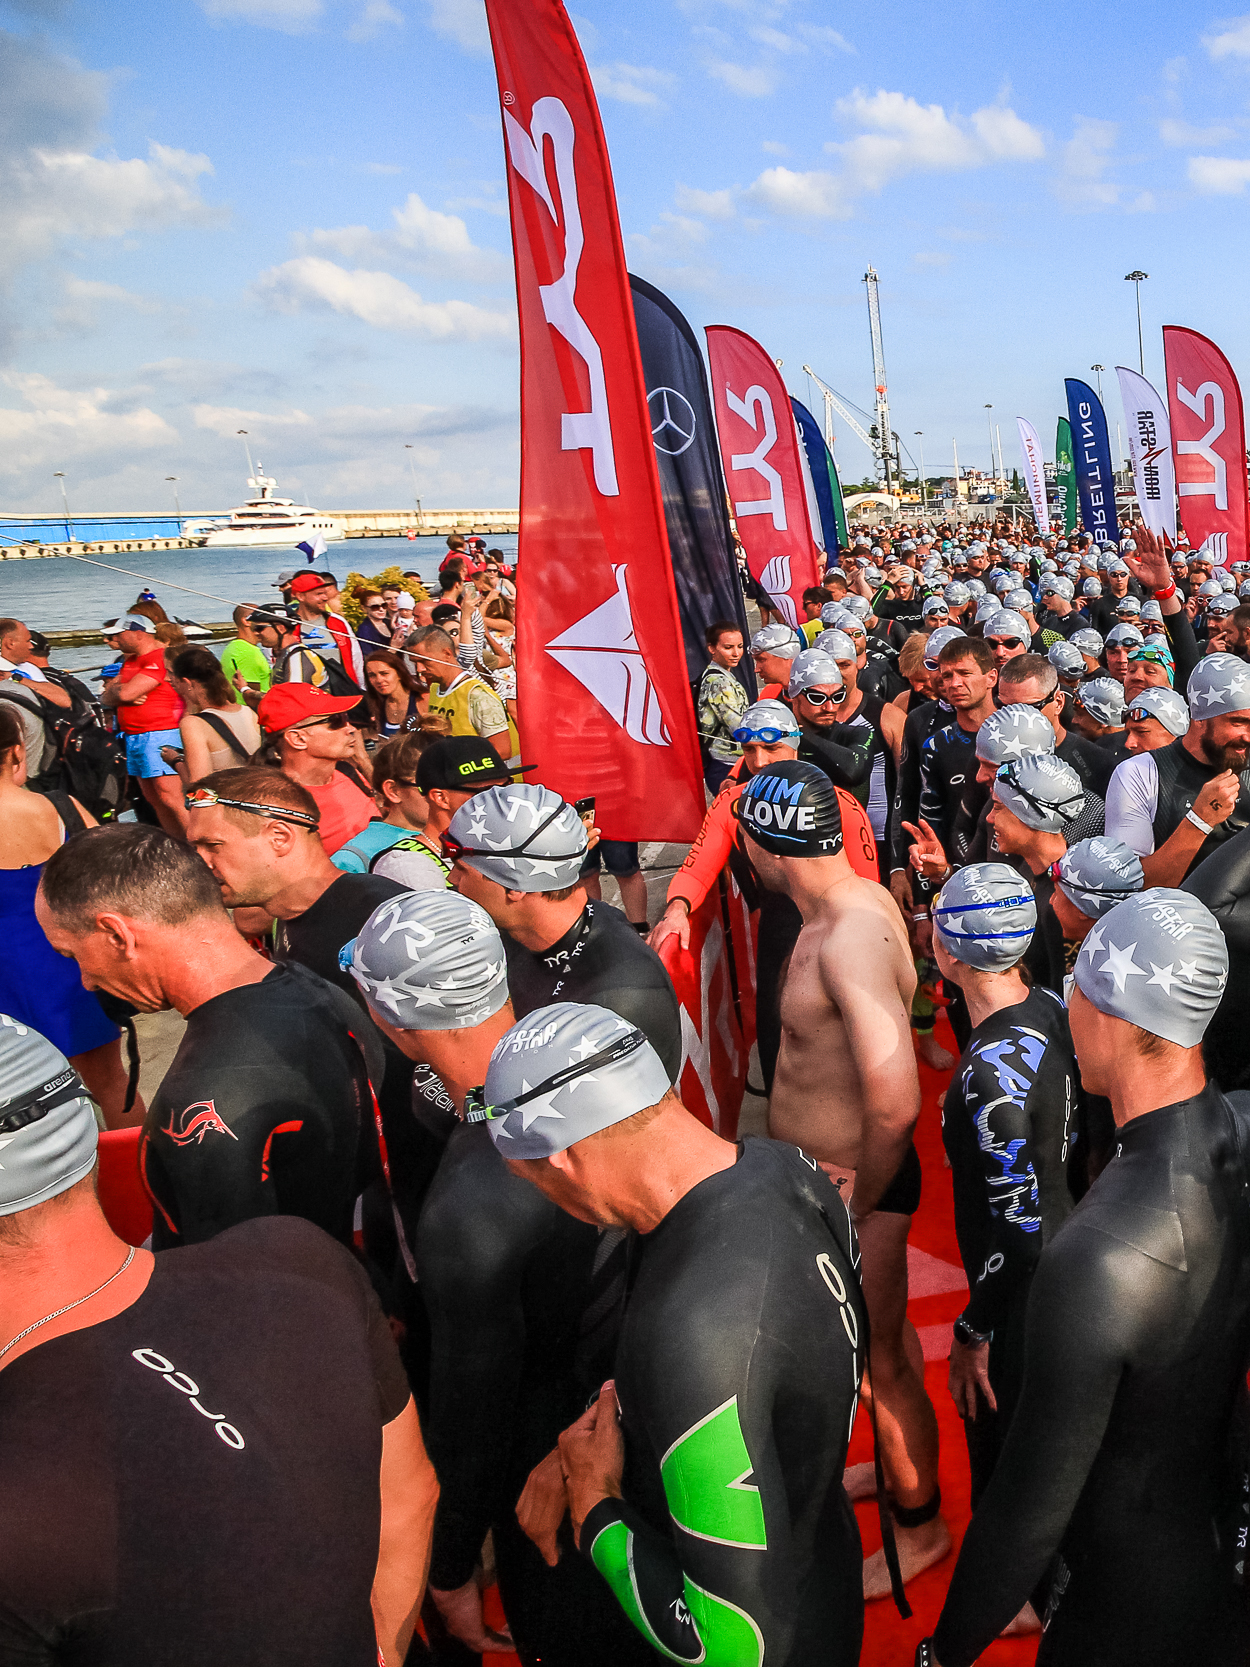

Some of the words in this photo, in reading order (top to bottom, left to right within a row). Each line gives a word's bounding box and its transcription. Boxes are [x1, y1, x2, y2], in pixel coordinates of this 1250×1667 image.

[1010, 710, 1049, 731] TYR
[743, 796, 817, 832] LOVE
[454, 1004, 492, 1026] TYR
[43, 1071, 72, 1092] arena
[131, 1347, 246, 1450] orca
